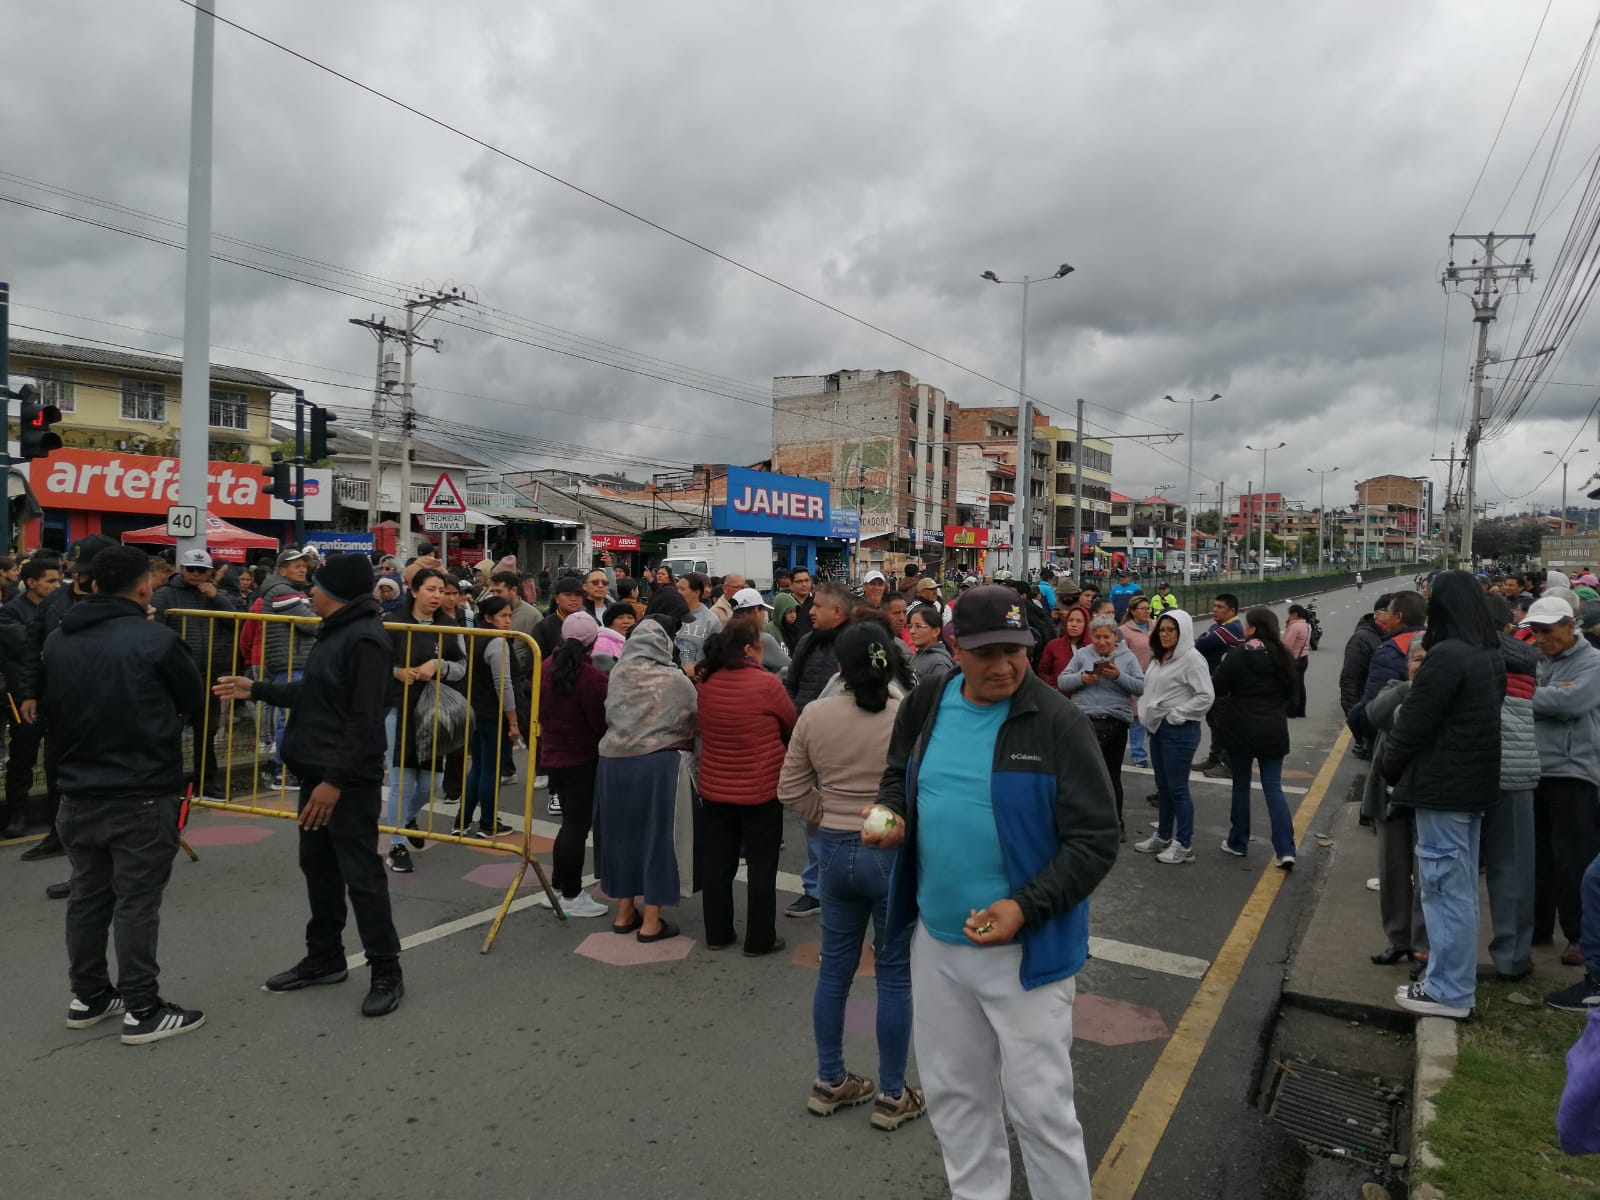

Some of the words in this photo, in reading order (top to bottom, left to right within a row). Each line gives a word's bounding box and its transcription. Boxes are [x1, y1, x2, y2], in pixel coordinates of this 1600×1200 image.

[734, 485, 824, 521] JAHER
[172, 514, 192, 529] 40
[426, 514, 463, 522] PRIORIDAD
